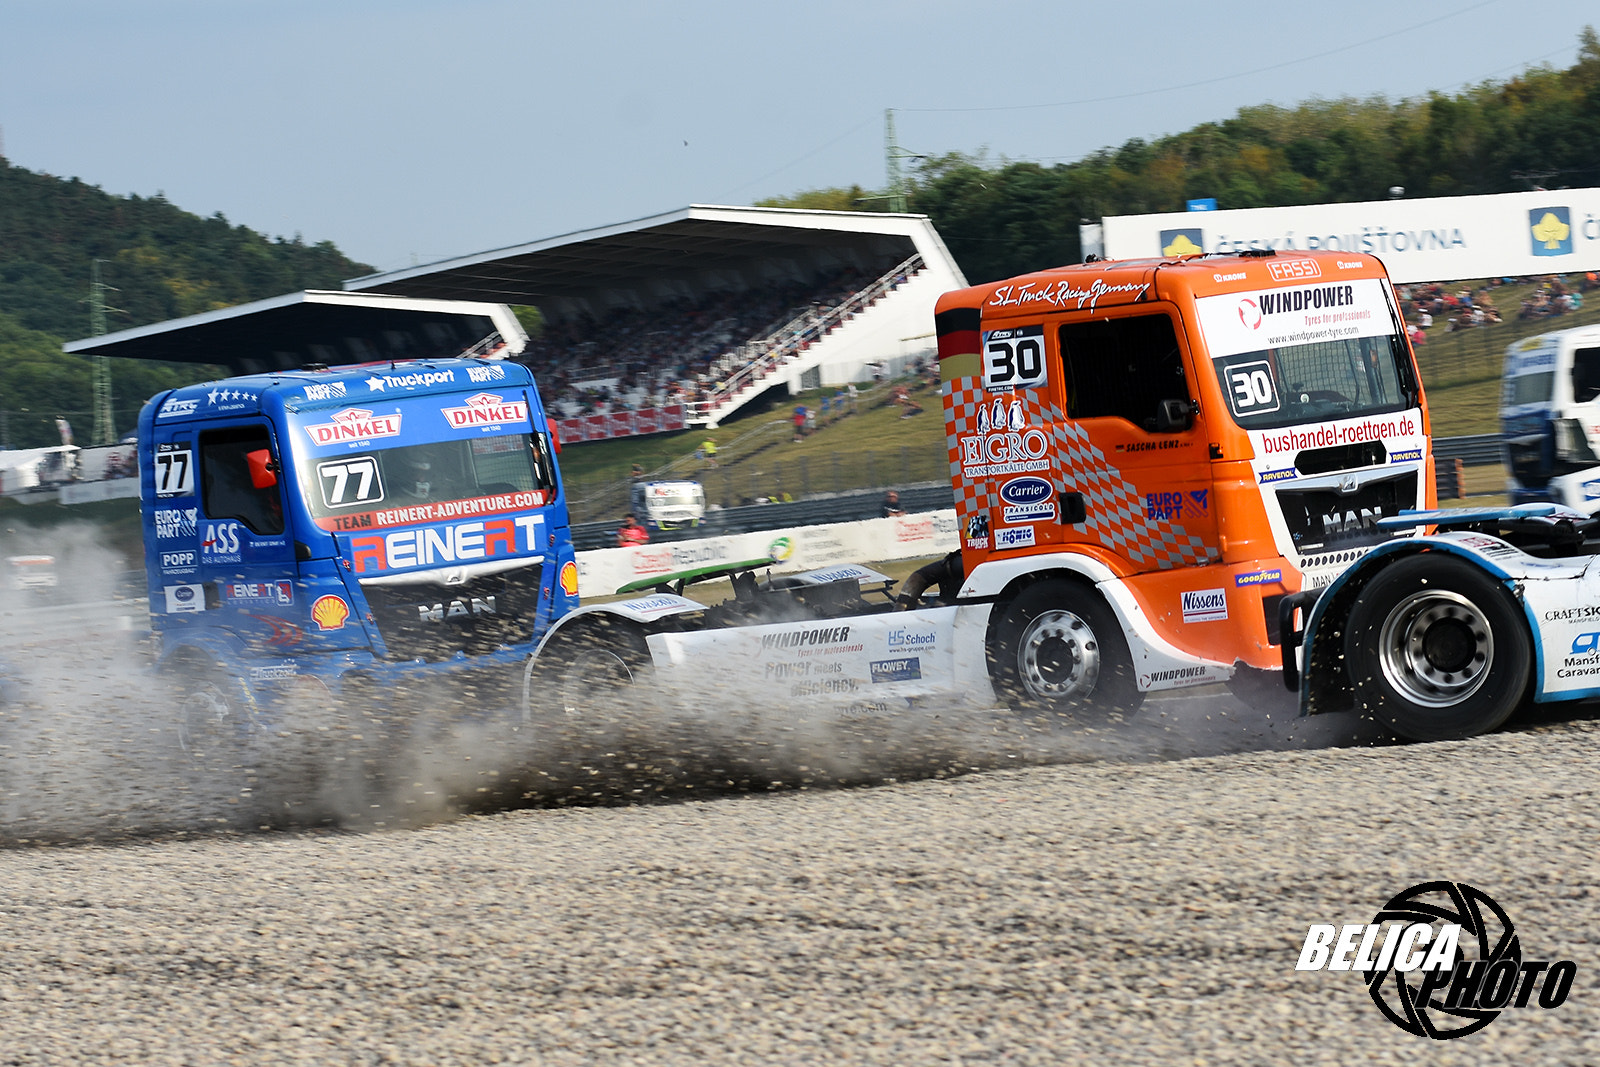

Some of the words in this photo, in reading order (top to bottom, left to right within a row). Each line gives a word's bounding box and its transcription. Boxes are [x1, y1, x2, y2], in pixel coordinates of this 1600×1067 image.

[1274, 260, 1319, 279] FASSI
[1090, 279, 1151, 314] Germany
[1259, 286, 1354, 315] WINDPOWER
[1305, 315, 1321, 327] Tyres
[1322, 313, 1332, 323] for
[1332, 310, 1371, 324] professionals
[1268, 326, 1360, 344] www.windpower-tyre.com
[989, 339, 1042, 383] 30
[383, 369, 455, 389] Truckport
[1230, 370, 1273, 408] 30
[453, 404, 525, 425] DINKEL
[317, 418, 397, 443] DINKEL
[1262, 415, 1415, 454] bushandel-roettgen.de
[961, 430, 1048, 465] EIGRO
[1126, 441, 1157, 452] SASCHA
[1159, 439, 1180, 449] LENZ
[158, 453, 188, 490] 77
[965, 461, 1025, 477] TRANSPORTKÄLTE
[1026, 460, 1049, 471] GMBH
[321, 461, 375, 503] 77
[1008, 484, 1045, 497] Carrier
[1005, 503, 1054, 514] TRANSICOLD
[1147, 492, 1183, 507] EURO
[154, 509, 181, 525] EURO
[333, 514, 372, 531] TEAM
[376, 492, 544, 526] REINERT-ADVENTURE.COM
[1148, 505, 1184, 520] PART
[1322, 506, 1383, 535] MAN
[156, 523, 181, 539] PART
[202, 523, 240, 554] ASS
[351, 514, 545, 573] REINERT
[967, 537, 989, 547] TRUCK
[163, 553, 194, 566] POPP
[1238, 571, 1281, 584] GOODYEAR
[418, 596, 497, 622] MAN
[1183, 592, 1225, 610] Nissens
[761, 627, 851, 649] WINDPOWER
[888, 630, 905, 646] HS
[905, 632, 935, 645] Schoch
[764, 661, 812, 680] Power
[813, 662, 843, 675] meets
[1151, 666, 1206, 682] WINDPOWER
